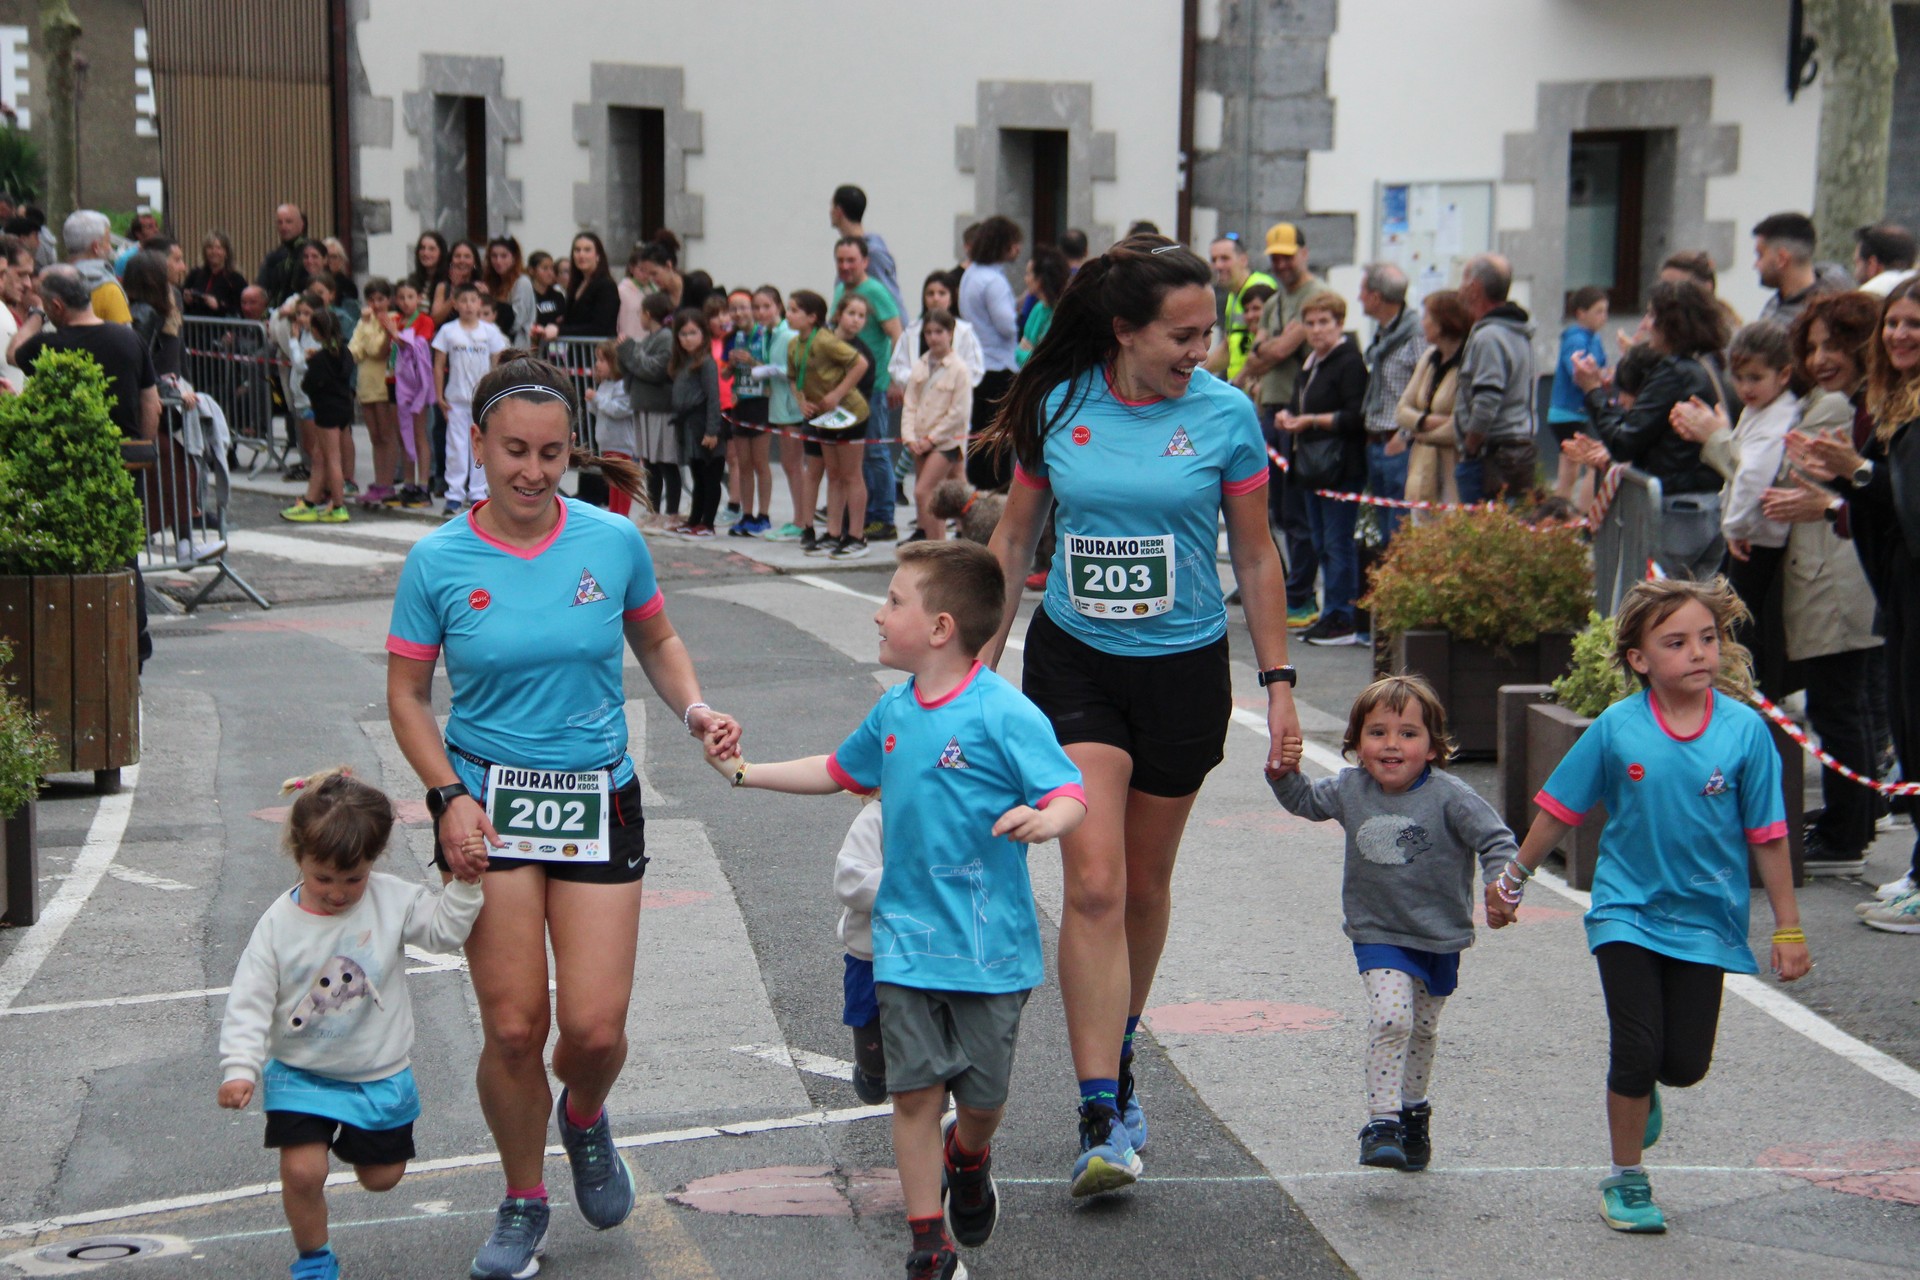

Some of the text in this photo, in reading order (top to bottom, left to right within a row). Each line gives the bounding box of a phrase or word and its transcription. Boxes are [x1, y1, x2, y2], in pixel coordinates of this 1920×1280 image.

[1071, 538, 1139, 555] IRURAKO
[1140, 539, 1164, 547] HERRI
[1140, 547, 1165, 555] KROSA
[1083, 564, 1152, 593] 203
[497, 769, 577, 791] IRURAKO
[577, 773, 599, 782] HERRI
[577, 783, 599, 791] KROSA
[508, 798, 586, 831] 202
